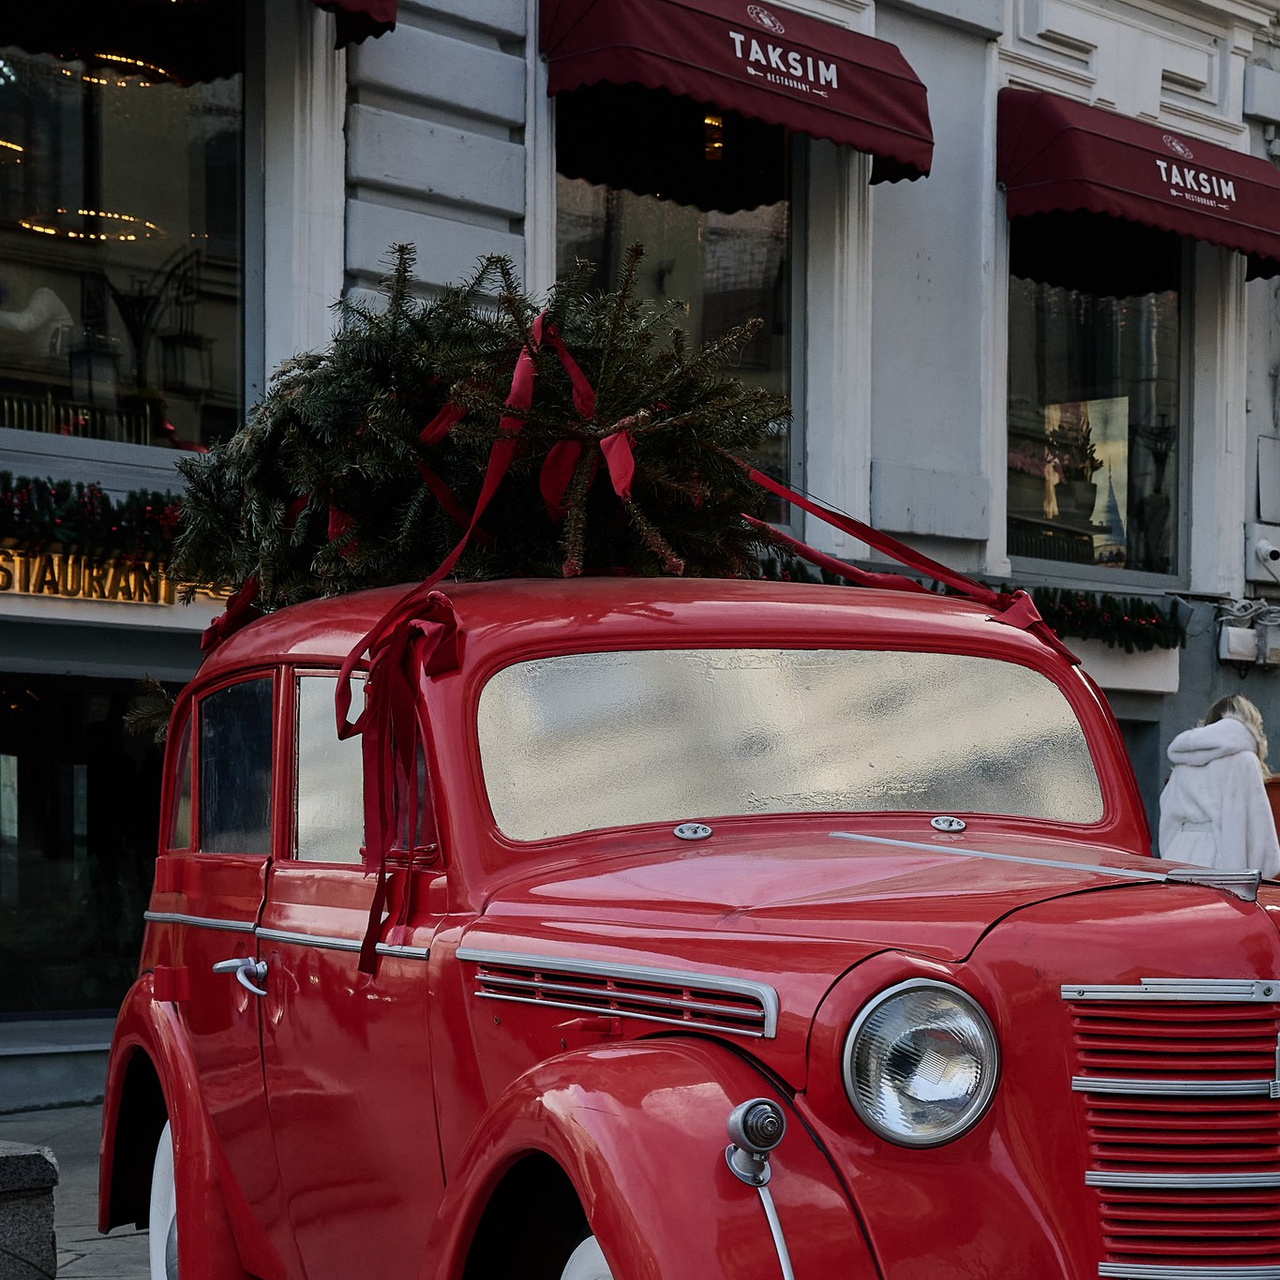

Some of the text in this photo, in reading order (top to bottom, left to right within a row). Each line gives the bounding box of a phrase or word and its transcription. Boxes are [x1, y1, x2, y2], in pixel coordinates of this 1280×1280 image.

[729, 30, 838, 89] TAKSIM
[766, 72, 810, 93] RESTAURANT
[1155, 159, 1236, 202] TAKSIM
